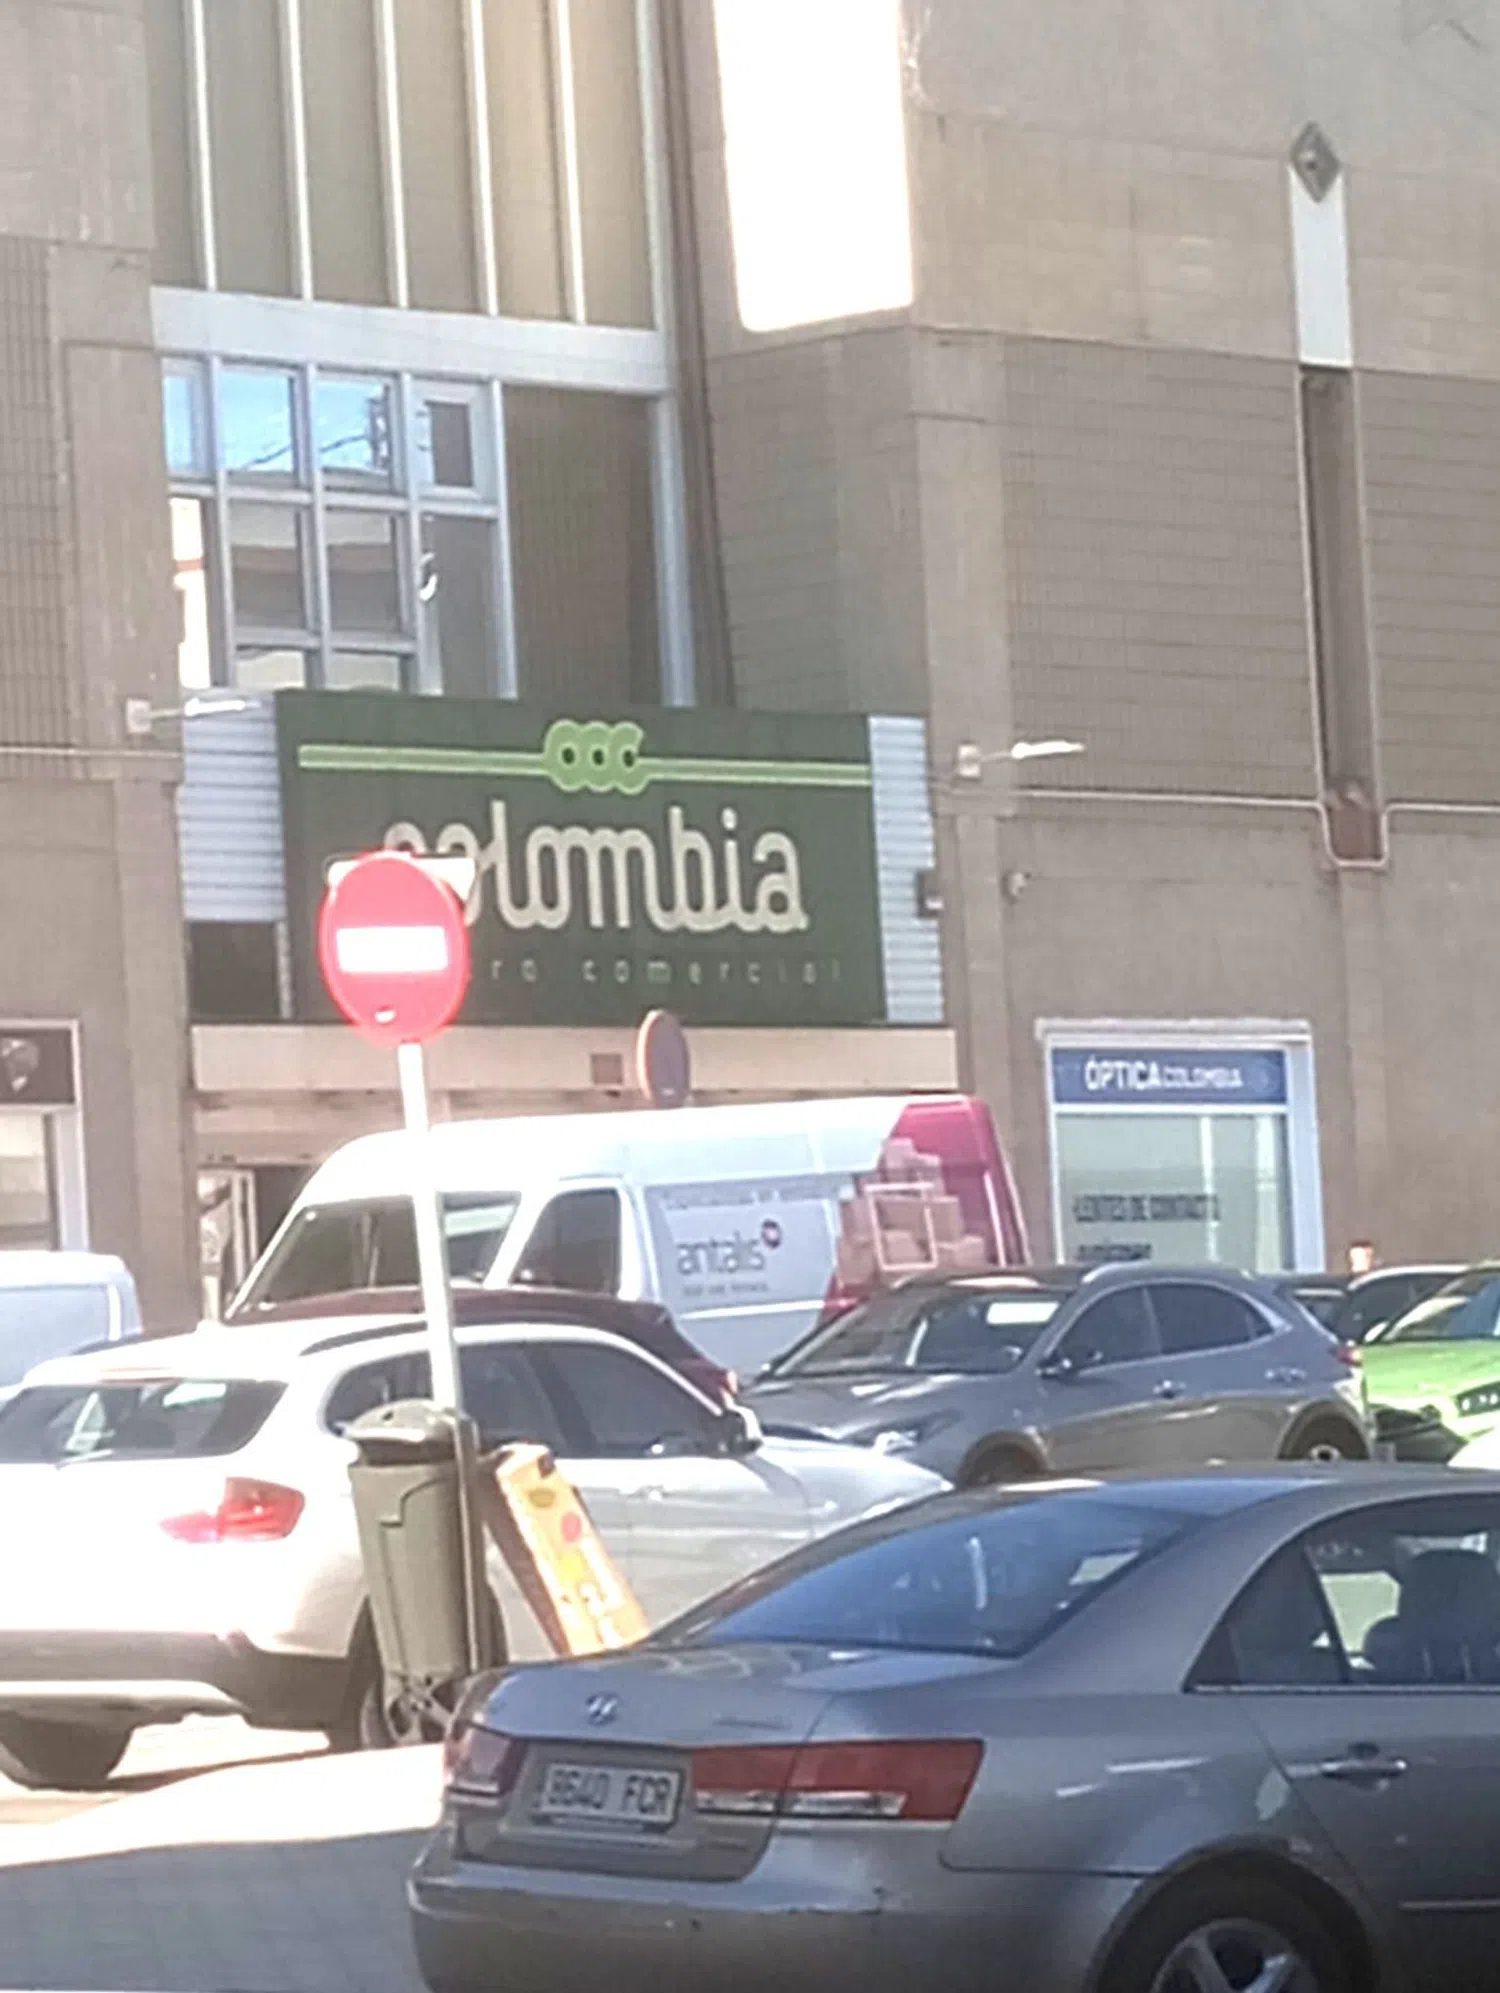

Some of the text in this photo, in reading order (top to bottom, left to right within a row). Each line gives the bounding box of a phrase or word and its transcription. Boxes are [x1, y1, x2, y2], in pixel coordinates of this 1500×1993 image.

[581, 957, 841, 985] comercial
[1085, 1054, 1161, 1090] ÓPTICA
[677, 1229, 766, 1275] antalis
